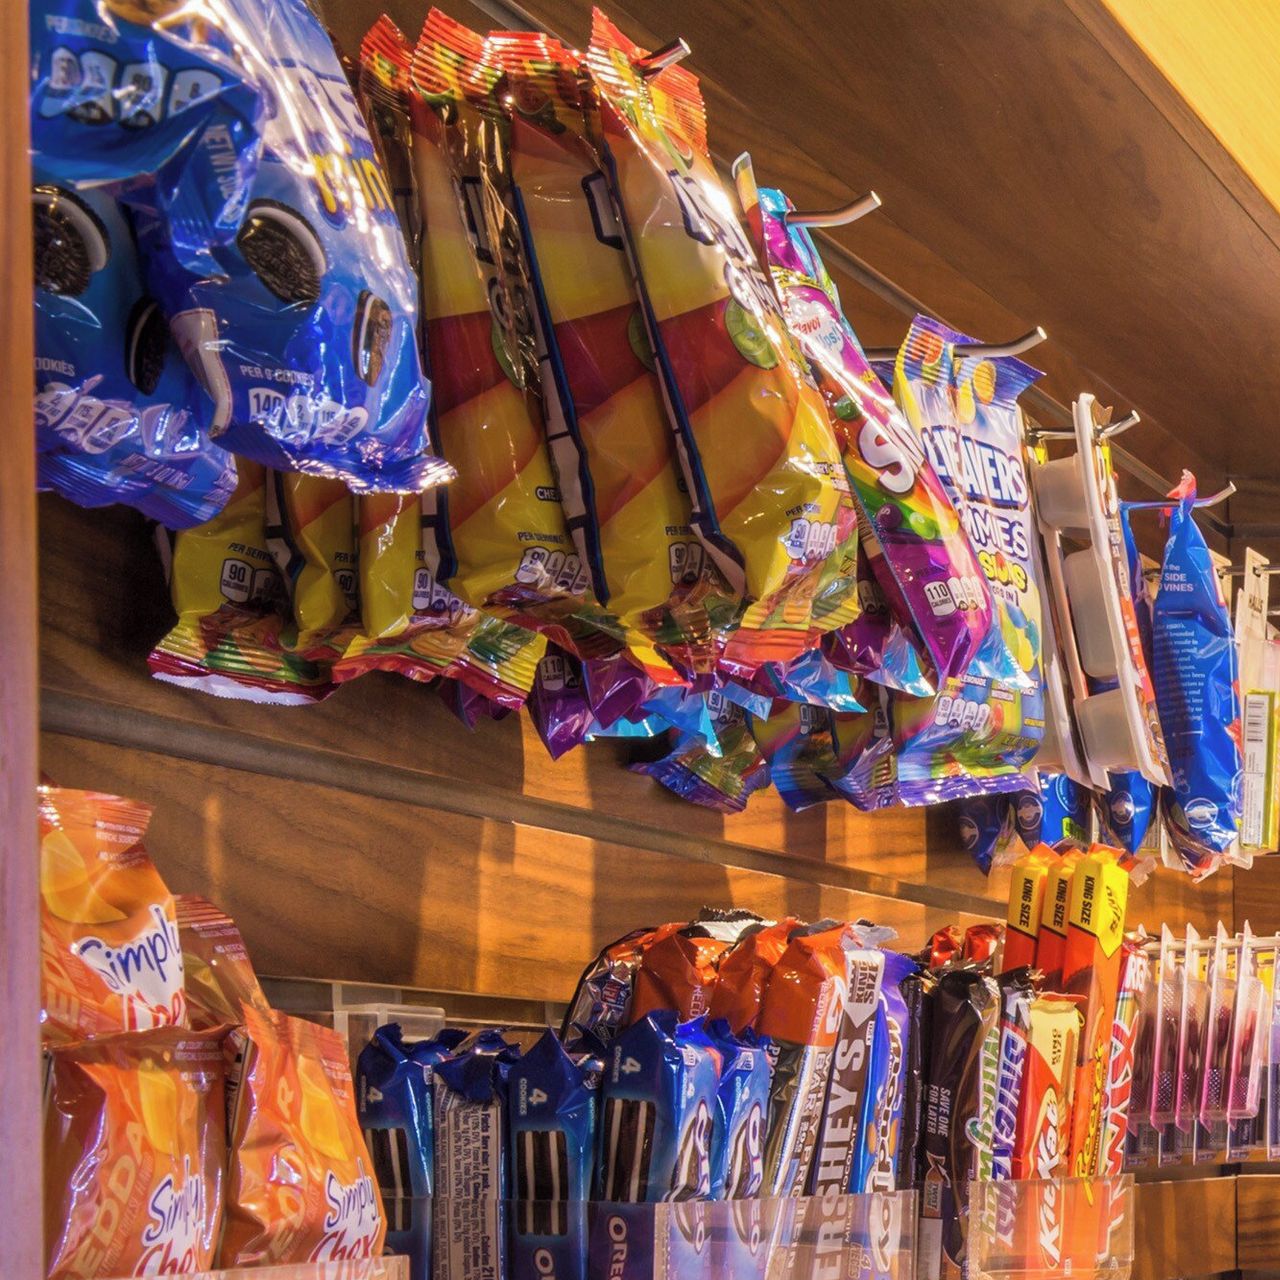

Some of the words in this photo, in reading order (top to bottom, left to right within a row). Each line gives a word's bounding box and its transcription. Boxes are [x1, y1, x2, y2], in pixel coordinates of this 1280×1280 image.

[1163, 582, 1194, 593] VINES
[1164, 572, 1187, 583] SIDE
[926, 584, 948, 599] 110
[1022, 877, 1034, 901] KING
[1056, 877, 1069, 902] KING
[1083, 874, 1096, 900] KING
[1019, 902, 1033, 928] SIZE
[1053, 903, 1066, 928] SIZE
[1080, 901, 1093, 926] SIZE
[856, 962, 868, 1004] KING
[865, 961, 880, 1004] SIZE
[611, 1045, 622, 1084] COOKIES
[621, 1055, 642, 1075] 4
[804, 1052, 827, 1112] BAR
[929, 1083, 940, 1102] FOR
[518, 1077, 528, 1116] COOKIES
[529, 1087, 548, 1105] 4
[938, 1087, 951, 1114] SAVE
[926, 1103, 938, 1135] LATER
[937, 1115, 949, 1138] ONE
[145, 1154, 200, 1242] Simply
[326, 1157, 378, 1229] Simply
[847, 1241, 861, 1280] PIECES
